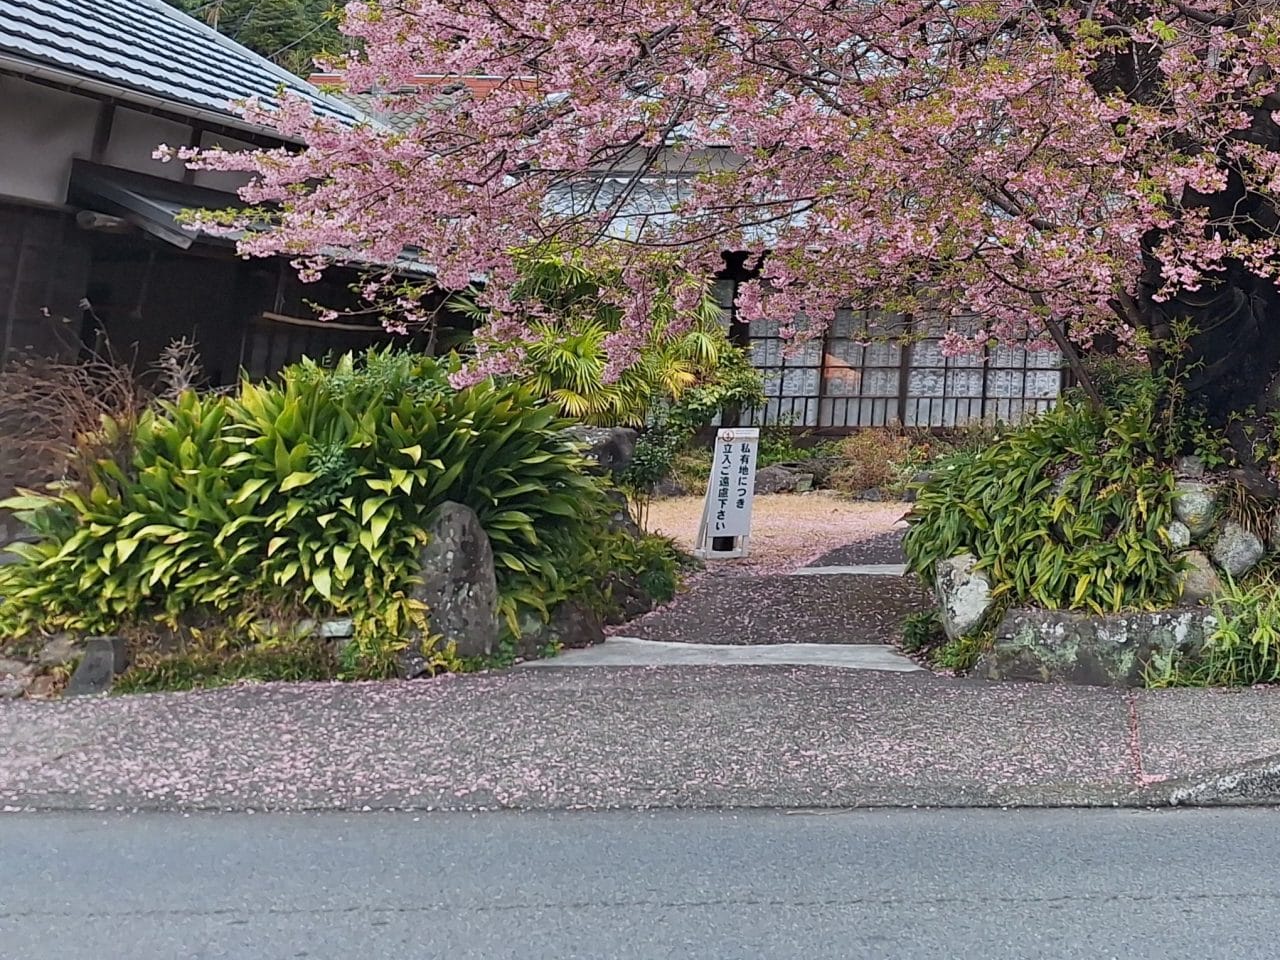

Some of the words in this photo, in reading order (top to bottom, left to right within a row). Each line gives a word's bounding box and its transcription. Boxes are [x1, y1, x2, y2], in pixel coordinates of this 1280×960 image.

[715, 443, 733, 531] 立入ご遠慮下さい
[735, 442, 751, 509] 私有地につき
